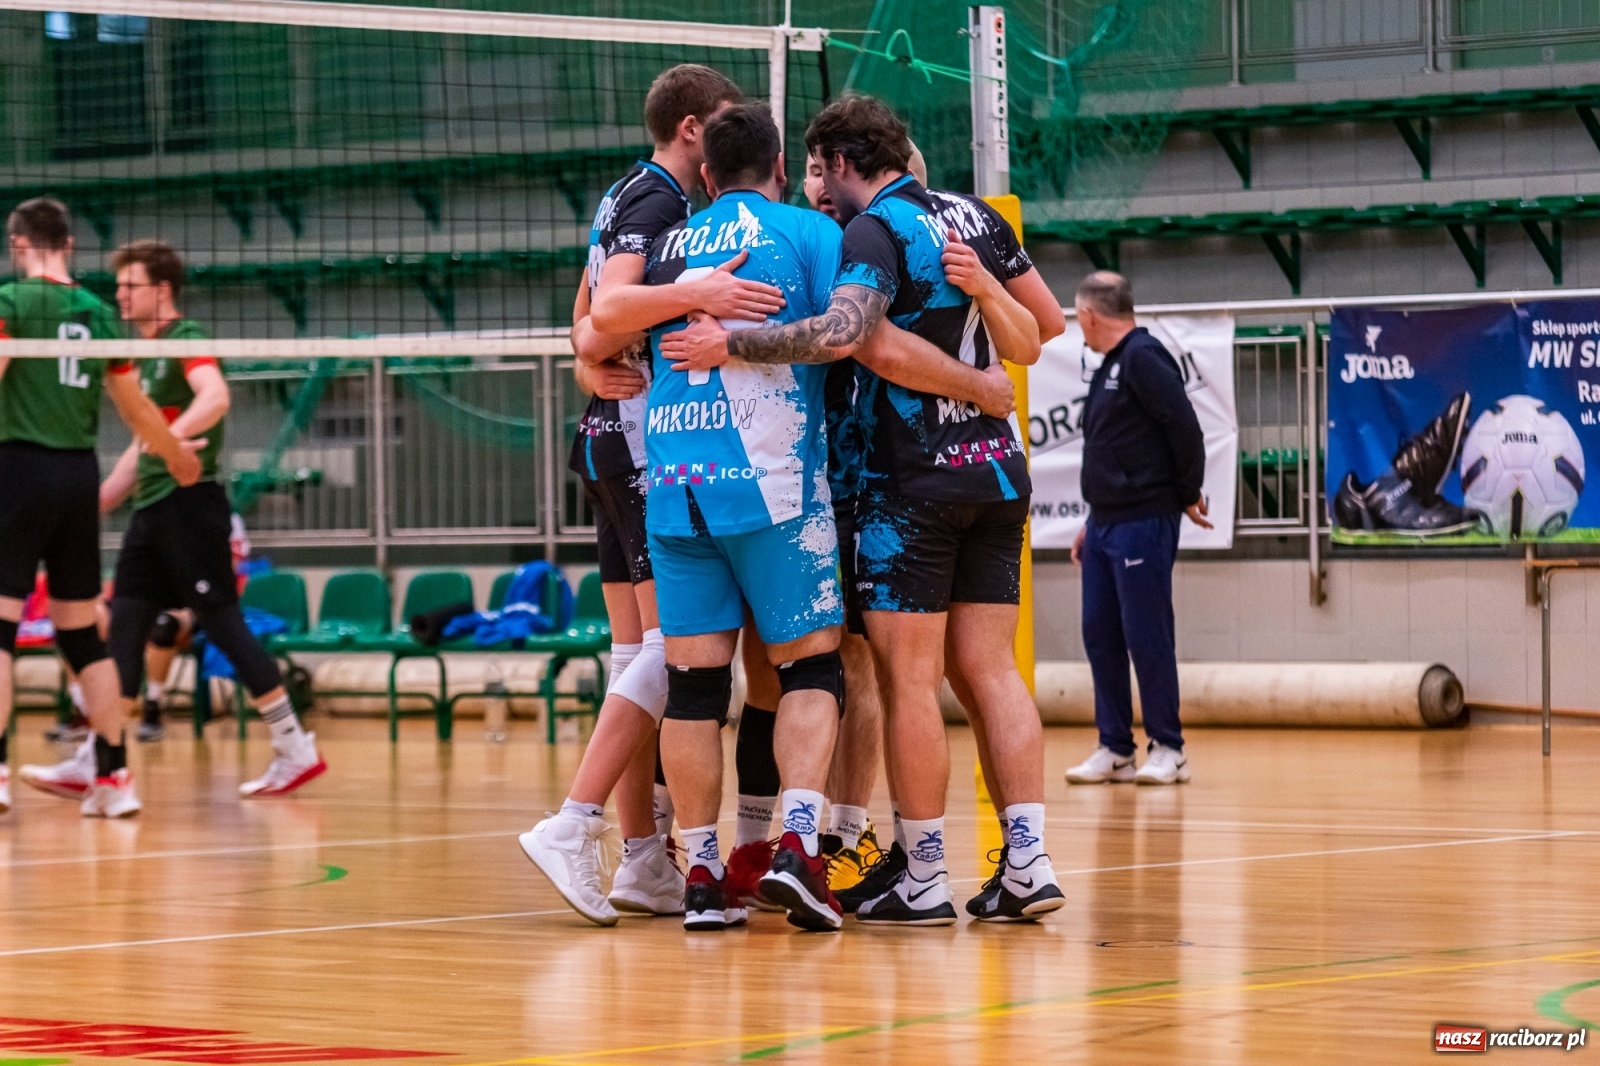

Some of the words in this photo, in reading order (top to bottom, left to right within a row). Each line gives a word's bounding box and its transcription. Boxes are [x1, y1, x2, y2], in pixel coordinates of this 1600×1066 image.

[660, 217, 760, 263] TRÓJKA
[1532, 319, 1565, 338] Sklep
[1566, 320, 1600, 338] sport
[58, 322, 92, 388] 12
[1340, 353, 1415, 384] Joma
[1528, 340, 1574, 368] MW
[1580, 340, 1600, 368] S
[647, 391, 757, 437] MIKOŁÓW
